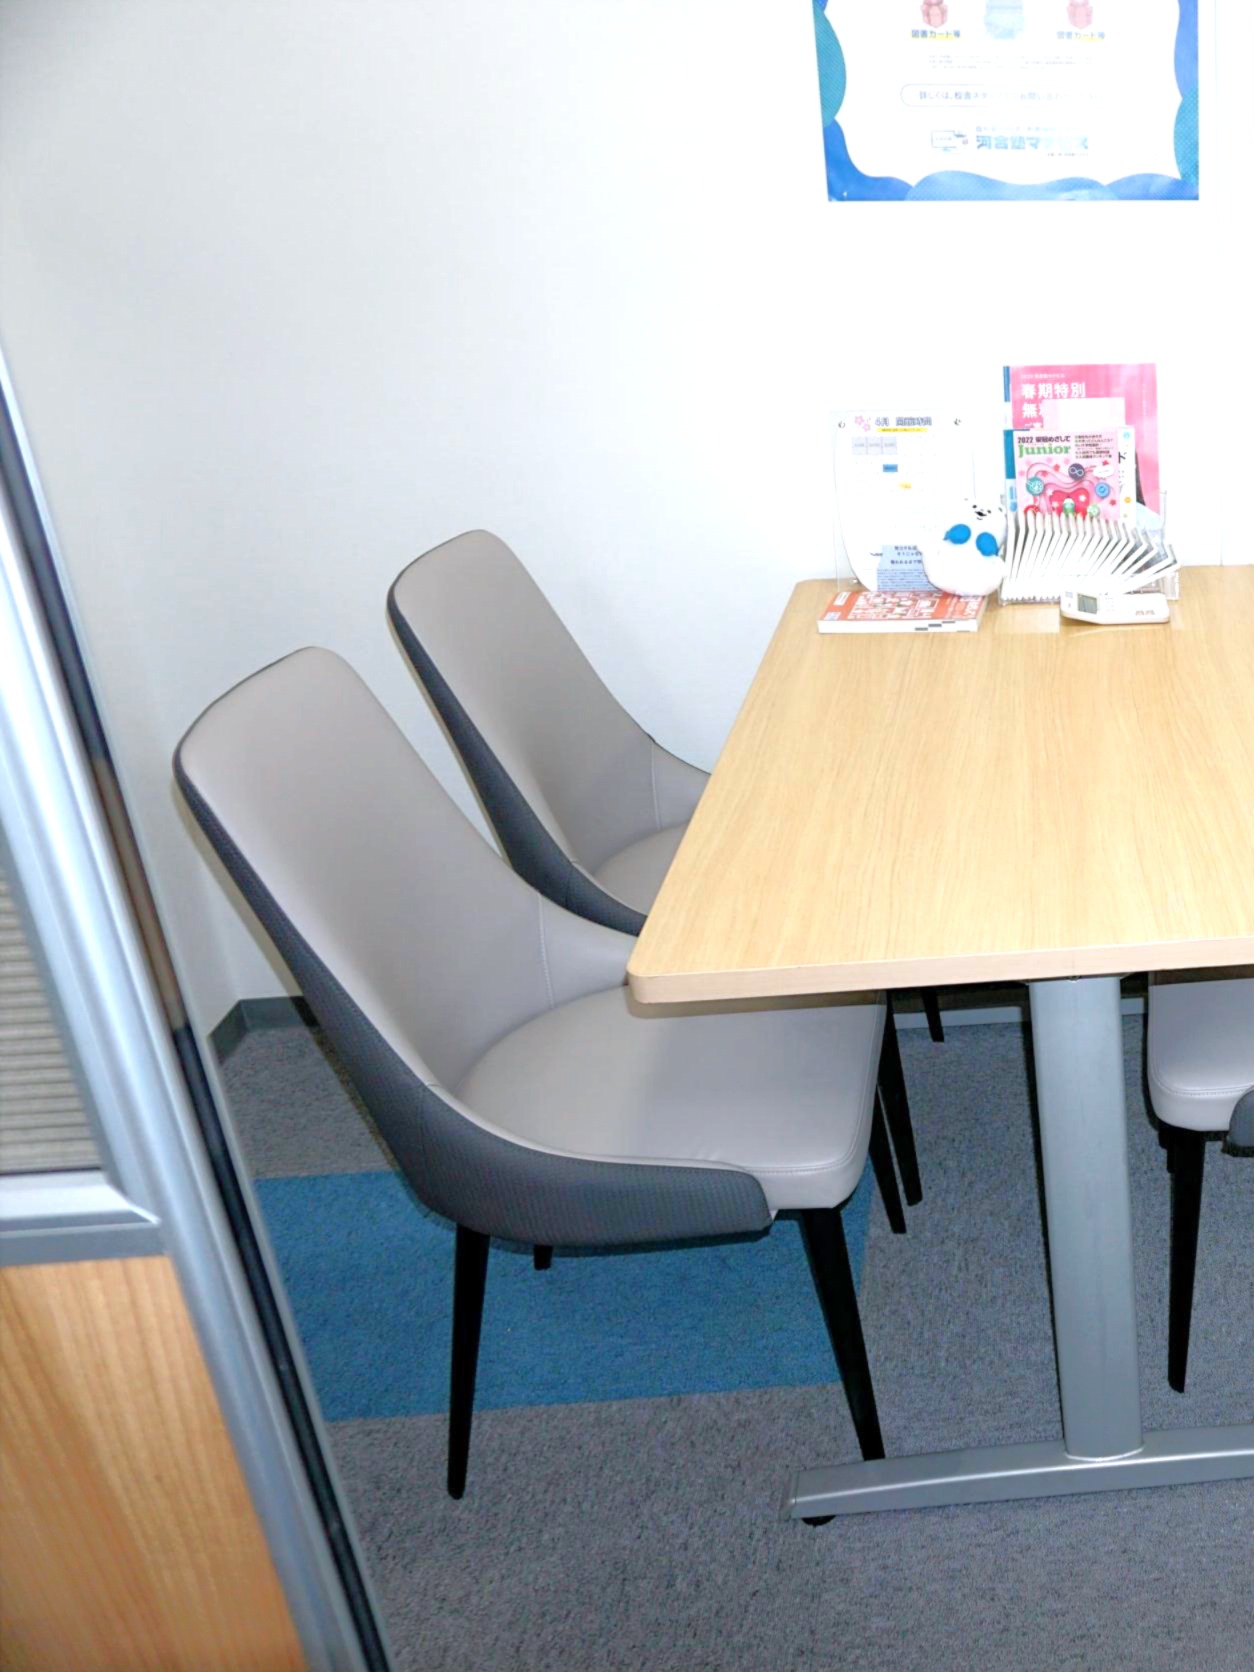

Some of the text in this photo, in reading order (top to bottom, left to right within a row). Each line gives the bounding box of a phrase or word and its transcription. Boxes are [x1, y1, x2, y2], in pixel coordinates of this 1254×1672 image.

[1021, 381, 1087, 399] 春期特別
[1017, 436, 1033, 444] 2022
[1017, 443, 1072, 459] Junior
